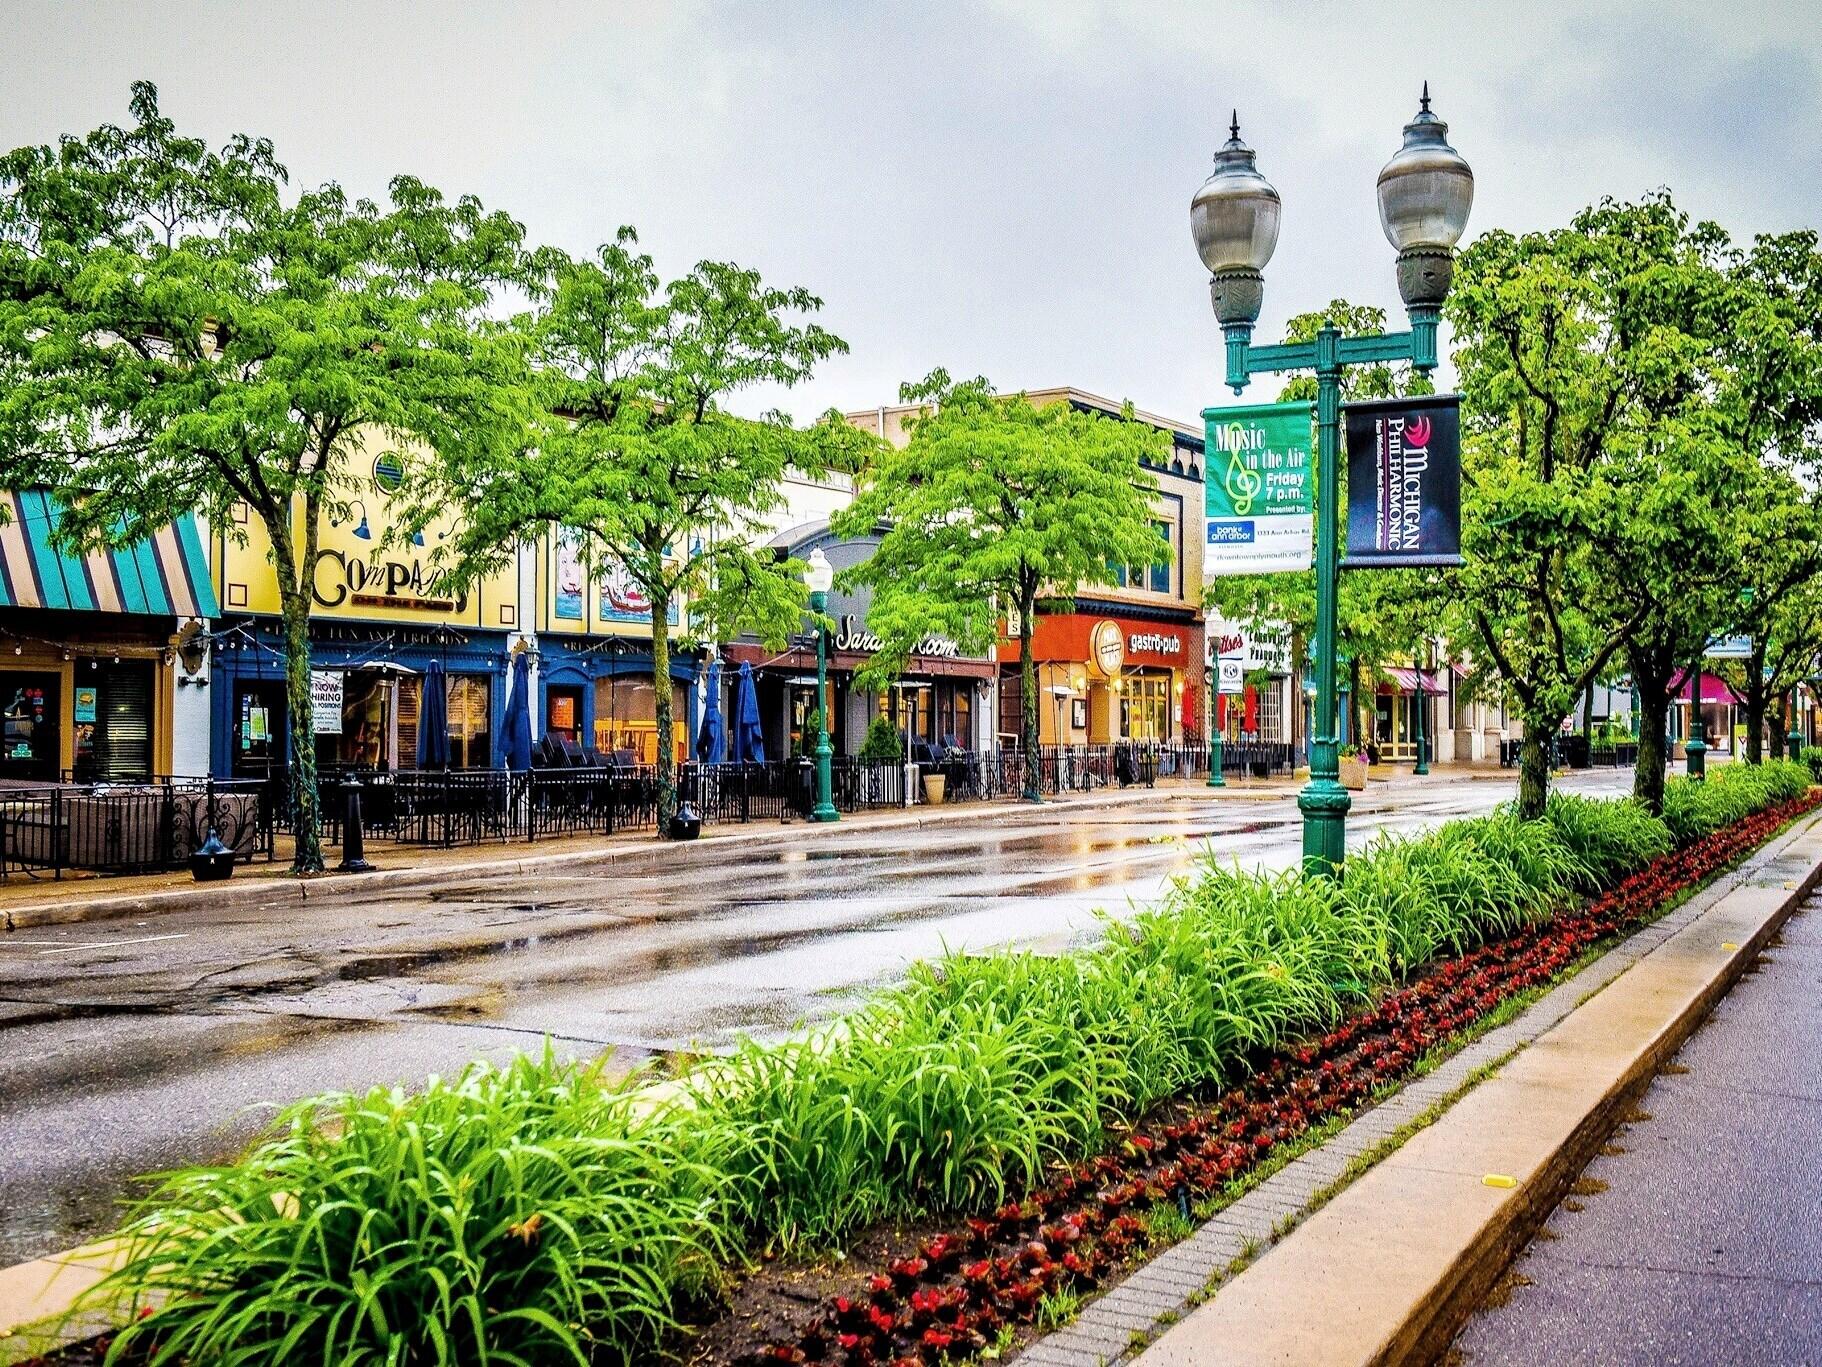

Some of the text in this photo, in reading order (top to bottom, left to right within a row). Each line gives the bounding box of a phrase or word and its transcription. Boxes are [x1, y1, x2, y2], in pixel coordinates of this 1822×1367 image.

[1215, 422, 1265, 452] Music
[1246, 448, 1305, 469] in the Air
[1266, 472, 1304, 487] Friday
[1266, 487, 1304, 502] 7 p.m.
[1266, 505, 1295, 513] Presented
[1228, 532, 1250, 540] arbor
[315, 682, 338, 692] NOW
[312, 692, 341, 702] HIRING
